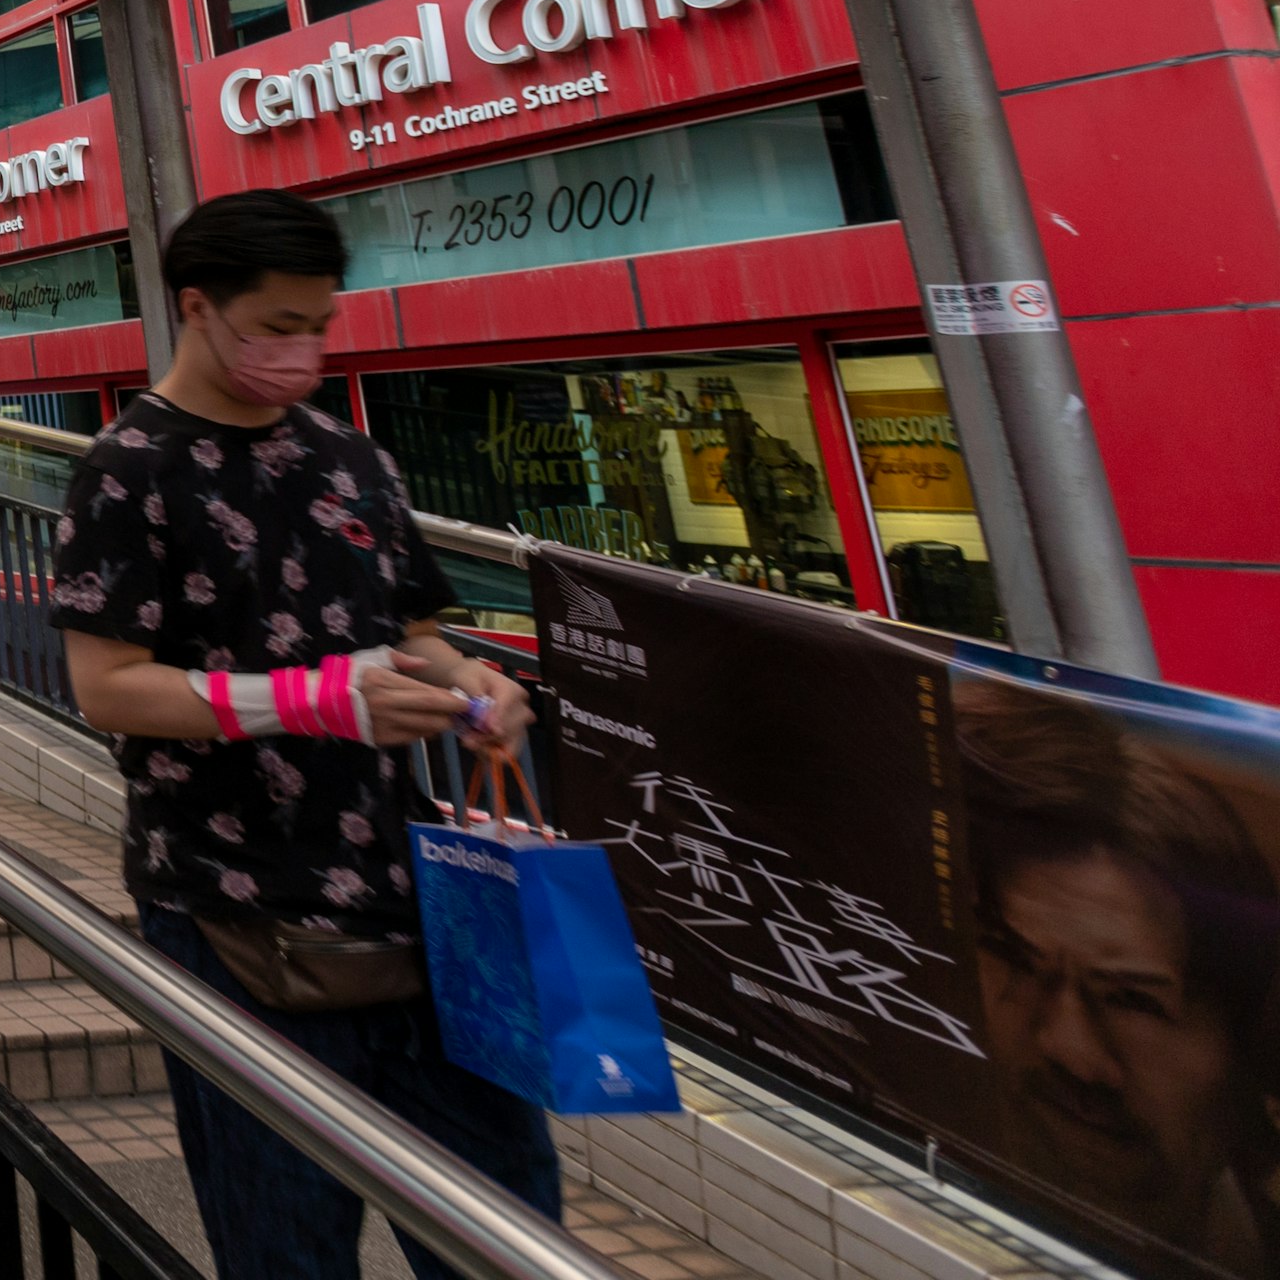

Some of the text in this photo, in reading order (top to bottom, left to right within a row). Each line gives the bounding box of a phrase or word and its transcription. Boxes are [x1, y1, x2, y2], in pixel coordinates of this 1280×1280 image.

[221, 3, 452, 135] Central
[350, 70, 609, 152] 9-11 Cochrane Street
[443, 194, 534, 252] 2353
[547, 173, 656, 233] 0001
[511, 458, 641, 486] FACTORY
[559, 697, 658, 750] Panasonic
